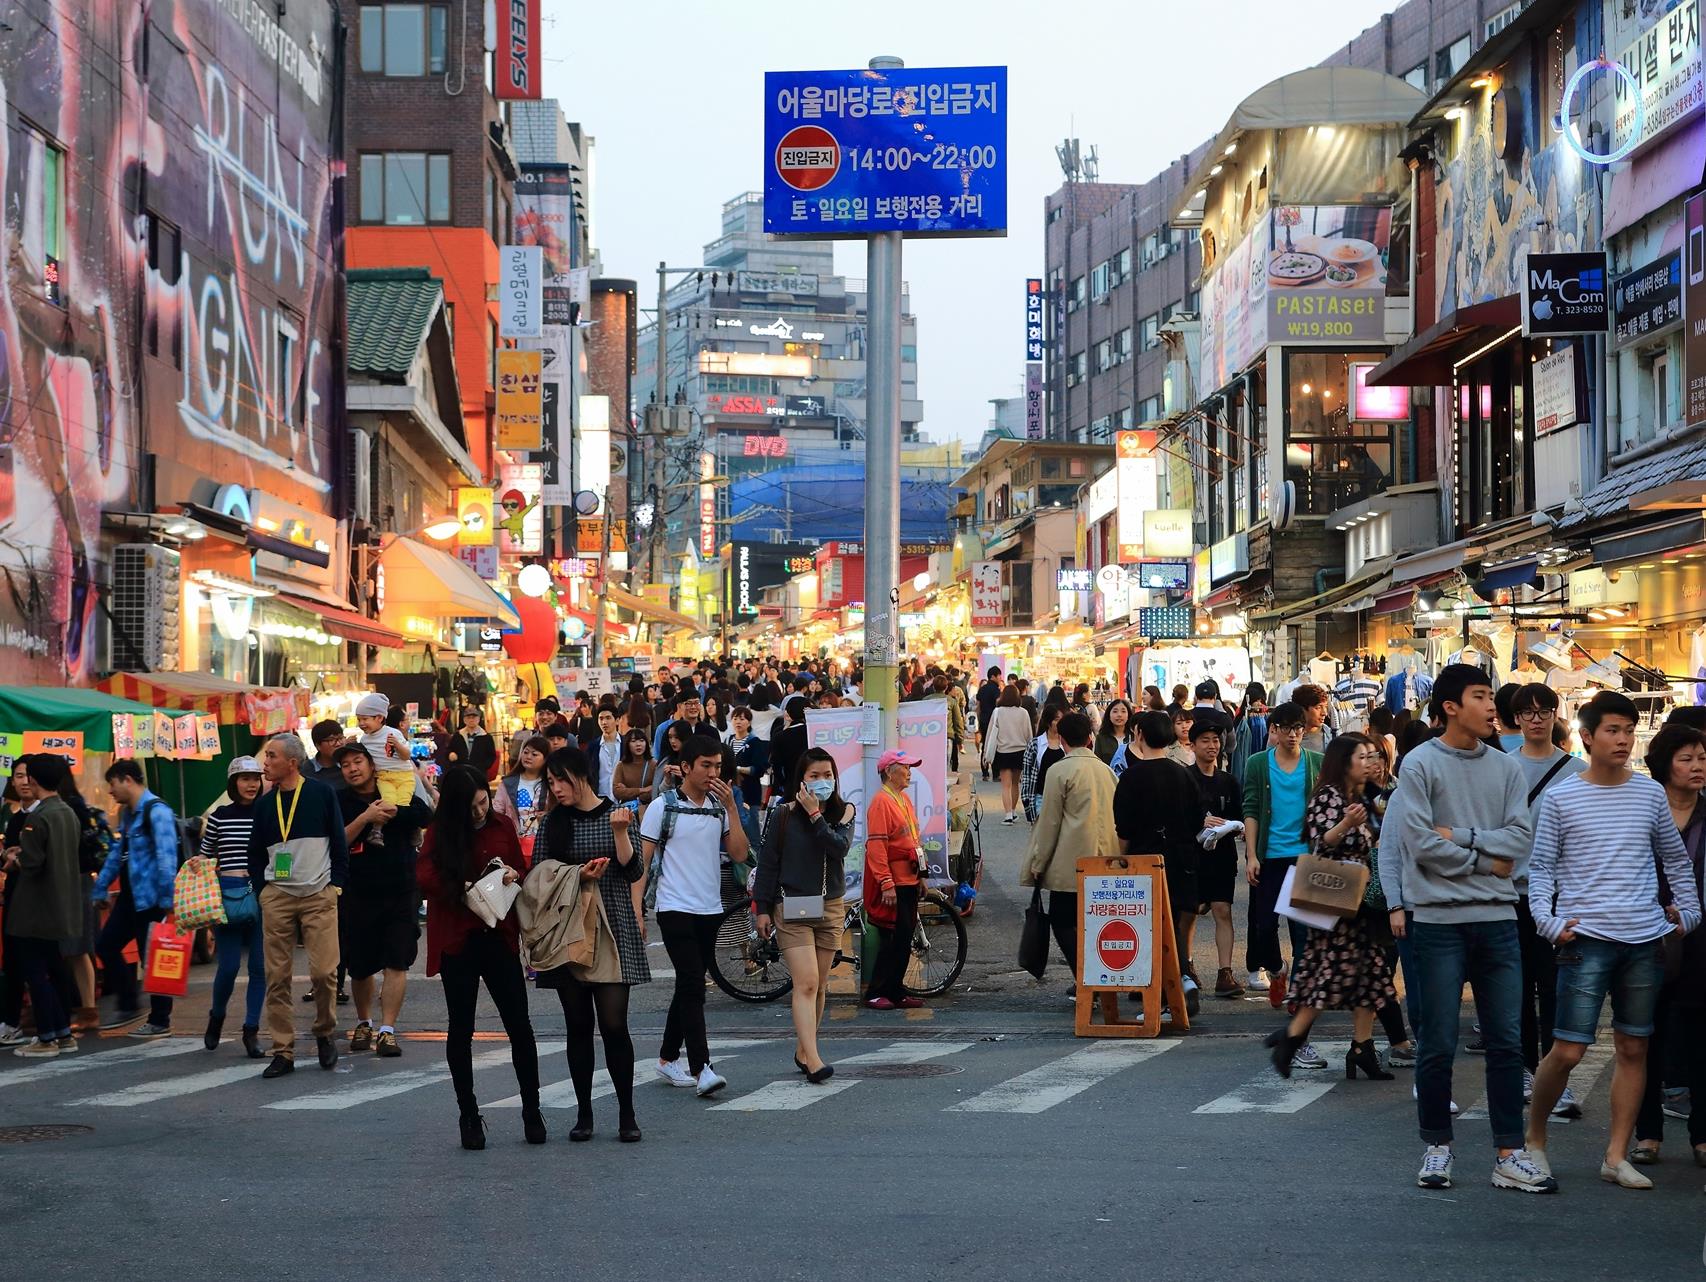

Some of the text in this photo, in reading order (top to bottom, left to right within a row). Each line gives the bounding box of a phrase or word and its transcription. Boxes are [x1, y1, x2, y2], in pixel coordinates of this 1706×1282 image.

[1669, 0, 1700, 65] 반지
[777, 81, 997, 119] 어울마당로 진입금지
[783, 150, 833, 166] 진입금지
[850, 145, 996, 171] 14:00~22:00
[875, 194, 943, 219] 보행전용
[949, 193, 982, 218] 거리
[552, 272, 567, 284] 2F
[1276, 295, 1376, 316] PASTAset
[1565, 305, 1604, 314] 323-8520
[1028, 293, 1041, 358] 호미화방
[744, 435, 789, 457] DVD
[1089, 903, 1147, 917] 차량출입금지
